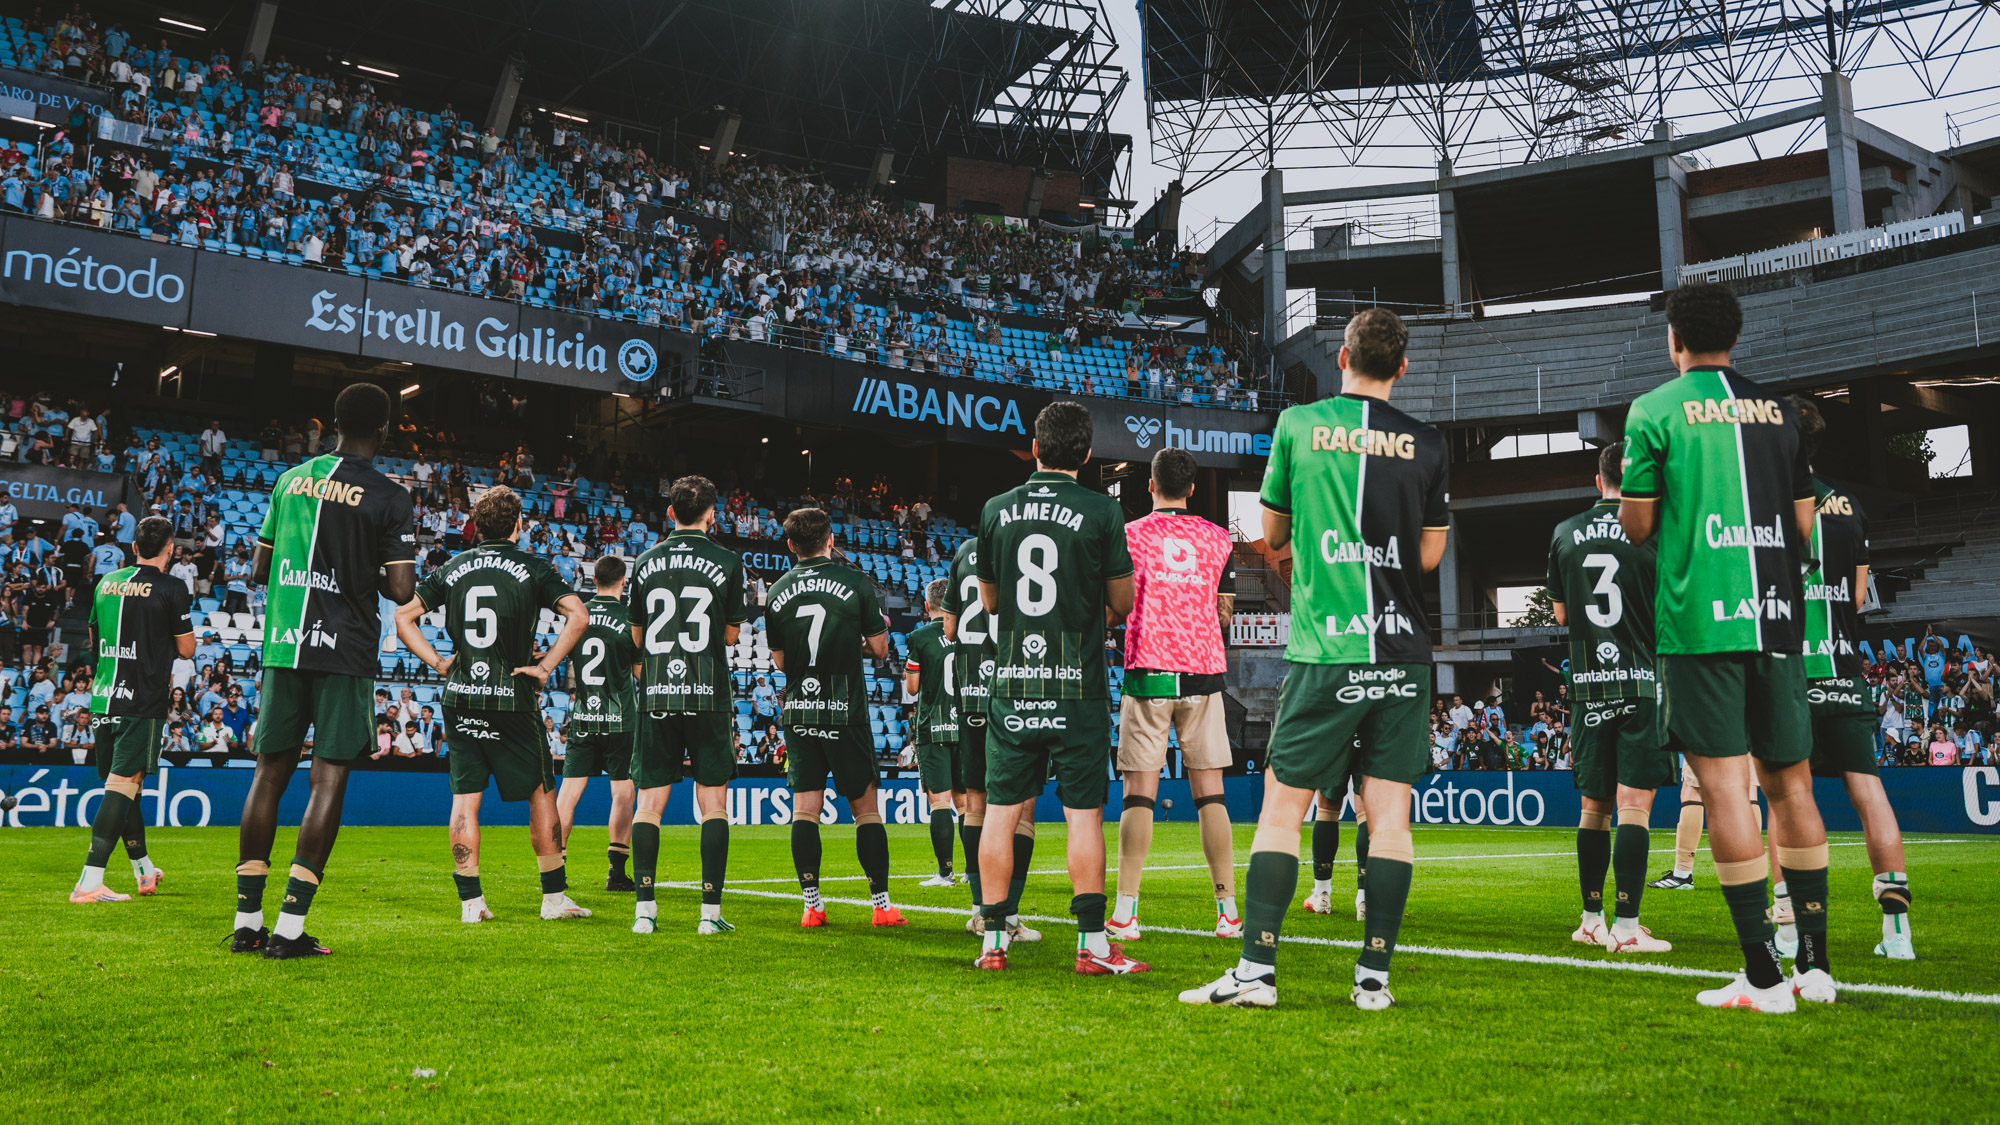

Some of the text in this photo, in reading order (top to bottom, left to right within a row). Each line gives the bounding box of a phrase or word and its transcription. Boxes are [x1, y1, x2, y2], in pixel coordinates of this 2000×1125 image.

[38, 92, 61, 109] DE
[4, 247, 185, 303] método
[305, 289, 608, 374] Estrella Galicia
[1682, 398, 1784, 425] RACING
[1165, 419, 1277, 456] humme
[1311, 425, 1415, 460] RACING
[286, 476, 365, 507] RACING
[999, 502, 1085, 532] ALMEIDA
[1572, 522, 1631, 546] AARO
[1705, 513, 1786, 550] CAMARSA
[637, 554, 728, 587] IVÁN MARTÍN
[742, 551, 792, 571] CELTA
[1016, 533, 1059, 617] 8
[1155, 571, 1208, 586] austral
[100, 581, 152, 597] RACING
[771, 578, 854, 613] GULIASHVILI
[1582, 553, 1624, 628] 3
[464, 585, 498, 649] 5
[645, 586, 714, 655] 23
[957, 574, 998, 645] 2
[588, 614, 626, 634] NTILLA
[795, 603, 827, 667] 7
[99, 638, 137, 660] CAMARSA
[582, 637, 606, 686] 2
[1055, 664, 1082, 681] labs
[1348, 667, 1406, 683] blendio
[1572, 667, 1655, 684] cantabria labs
[447, 681, 515, 697] cantabria labs
[694, 683, 714, 696] labs
[1366, 682, 1418, 700] GAC
[1827, 692, 1862, 705] GAC
[784, 698, 849, 711] antabria labs
[1014, 699, 1058, 711] blendio
[605, 712, 622, 723] labs
[931, 723, 959, 733] cantab
[1026, 716, 1067, 730] GAC
[0, 768, 212, 827] étodo
[693, 780, 839, 825] urss
